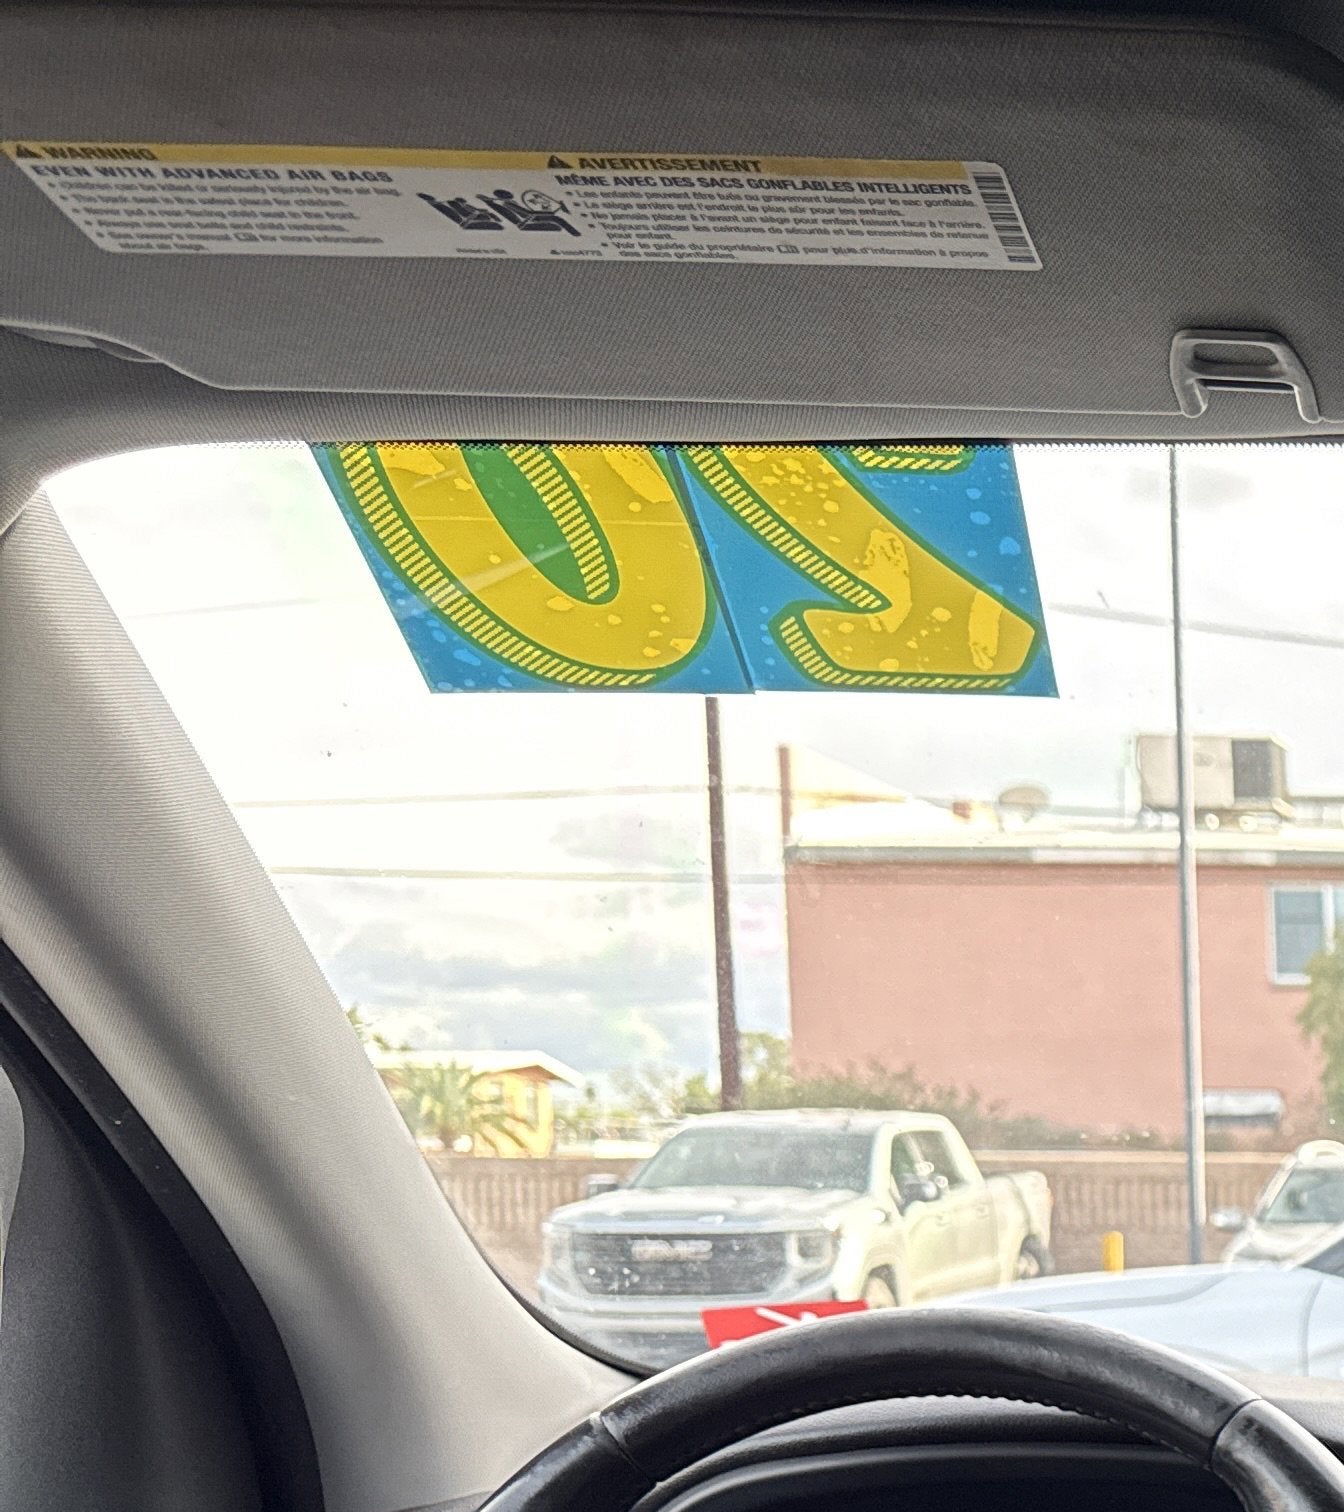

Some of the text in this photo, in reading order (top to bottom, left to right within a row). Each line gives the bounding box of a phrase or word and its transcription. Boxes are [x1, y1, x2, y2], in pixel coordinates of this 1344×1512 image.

[40, 147, 159, 160] WARNING
[579, 158, 762, 172] AVERTISSEMENT
[30, 165, 393, 182] EVEN WITH ADVANCED AIR BAGS
[555, 174, 972, 194] MÊME AVEC DES SACS GONFLABLES INTELLIGENTS
